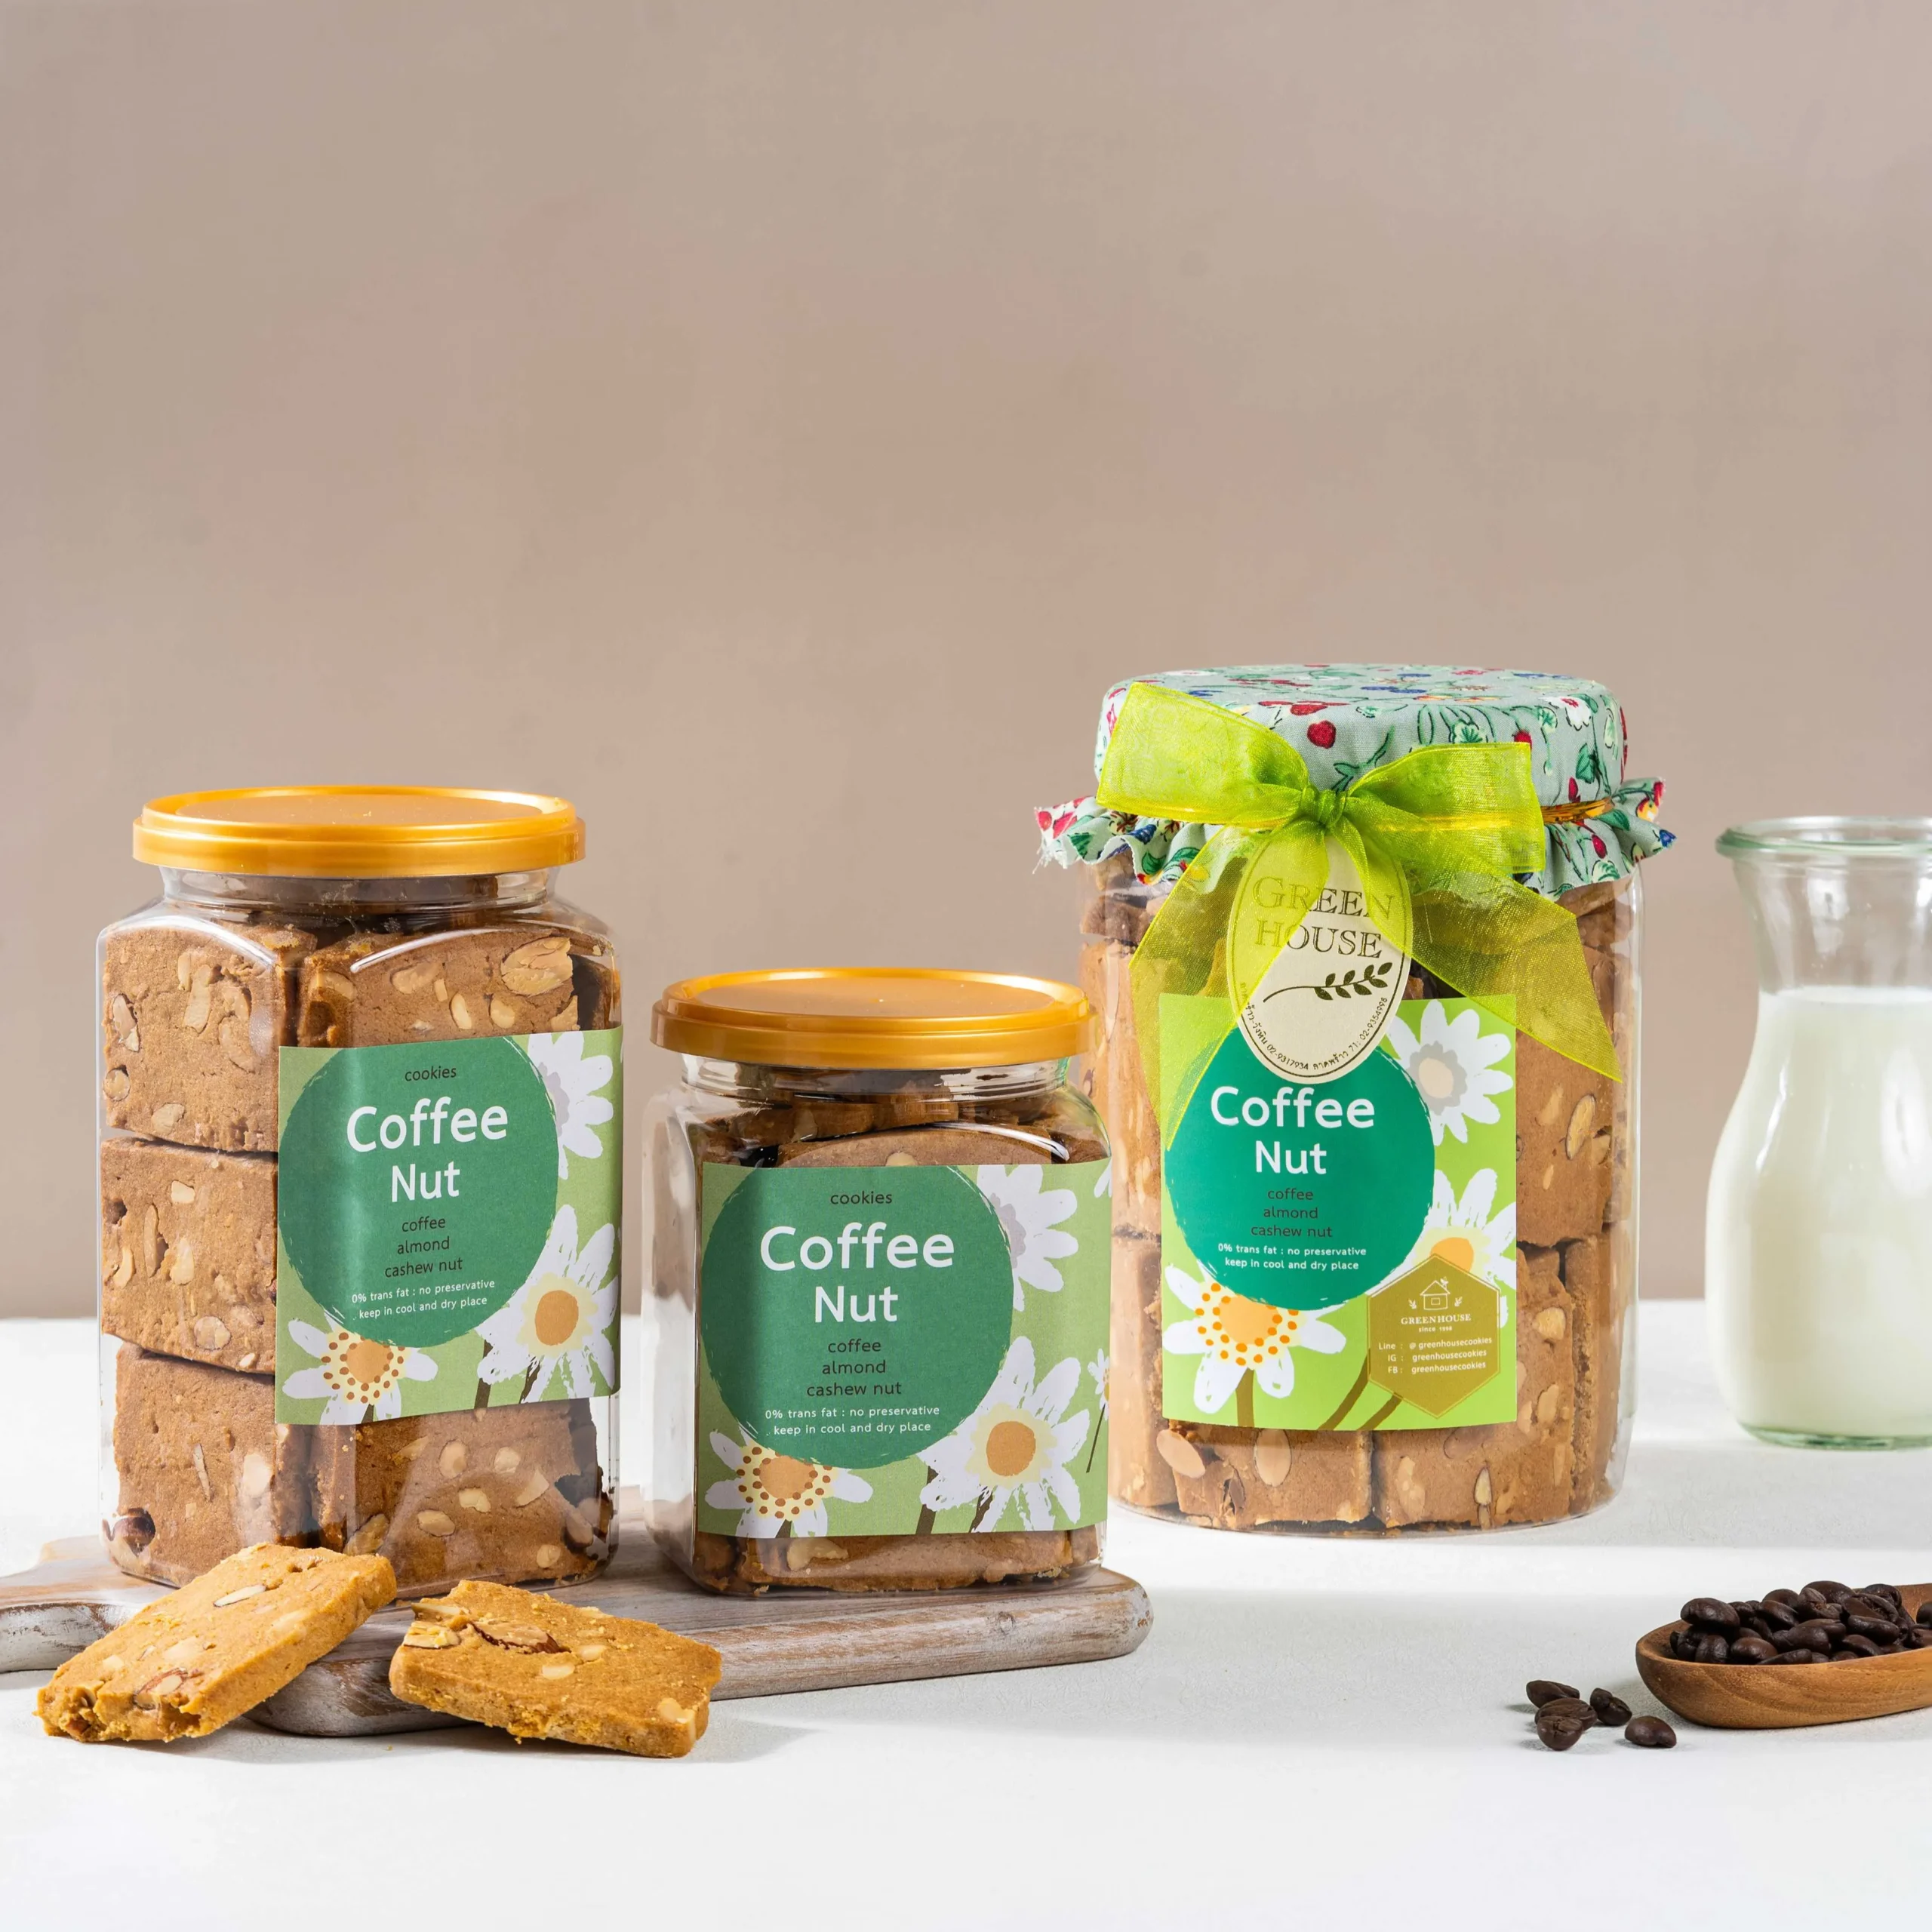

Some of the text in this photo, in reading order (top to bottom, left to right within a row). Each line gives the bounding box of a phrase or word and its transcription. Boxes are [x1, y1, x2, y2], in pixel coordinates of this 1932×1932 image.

[1253, 876, 1395, 918] GREEN
[1254, 918, 1383, 958] HOUSE
[405, 1066, 457, 1081] cookies
[1211, 1086, 1375, 1129] Coffee
[346, 1096, 508, 1152] Coffee
[1256, 1140, 1327, 1174] Nut
[392, 1161, 460, 1202] Nut
[830, 1190, 893, 1204] cookies
[1267, 1188, 1314, 1200] coffee
[1263, 1207, 1318, 1219] almond
[401, 1216, 446, 1232] coffee
[1251, 1224, 1333, 1238] cashew nut
[397, 1235, 450, 1255] almond
[760, 1221, 955, 1272] Coffee
[1218, 1243, 1232, 1252] 0%
[1235, 1244, 1260, 1254] trans
[1263, 1245, 1277, 1254] fat
[1304, 1247, 1367, 1257] preservative
[385, 1257, 463, 1278] cashew nut
[1225, 1257, 1359, 1271] keep in cool and dry place
[352, 1294, 367, 1303] 0%
[370, 1291, 393, 1302] trans
[396, 1287, 409, 1297] fat
[419, 1286, 432, 1295] no
[435, 1279, 495, 1296] preservative
[359, 1297, 488, 1319] keep in cool and dry place
[815, 1285, 899, 1323] Nut
[1401, 1313, 1472, 1324] GREENHOUSE
[828, 1338, 881, 1353] coffee
[1379, 1342, 1395, 1350] Line
[1412, 1349, 1487, 1363] greenhousecookies
[822, 1360, 886, 1374] almond
[1411, 1361, 1486, 1374] greenhousecookies
[807, 1382, 902, 1397] cashew nut
[765, 1409, 783, 1419] 0%
[788, 1409, 817, 1418] trans
[821, 1407, 837, 1417] fat
[869, 1405, 940, 1418] preservative
[774, 1422, 931, 1436] keep in cool and dry place
